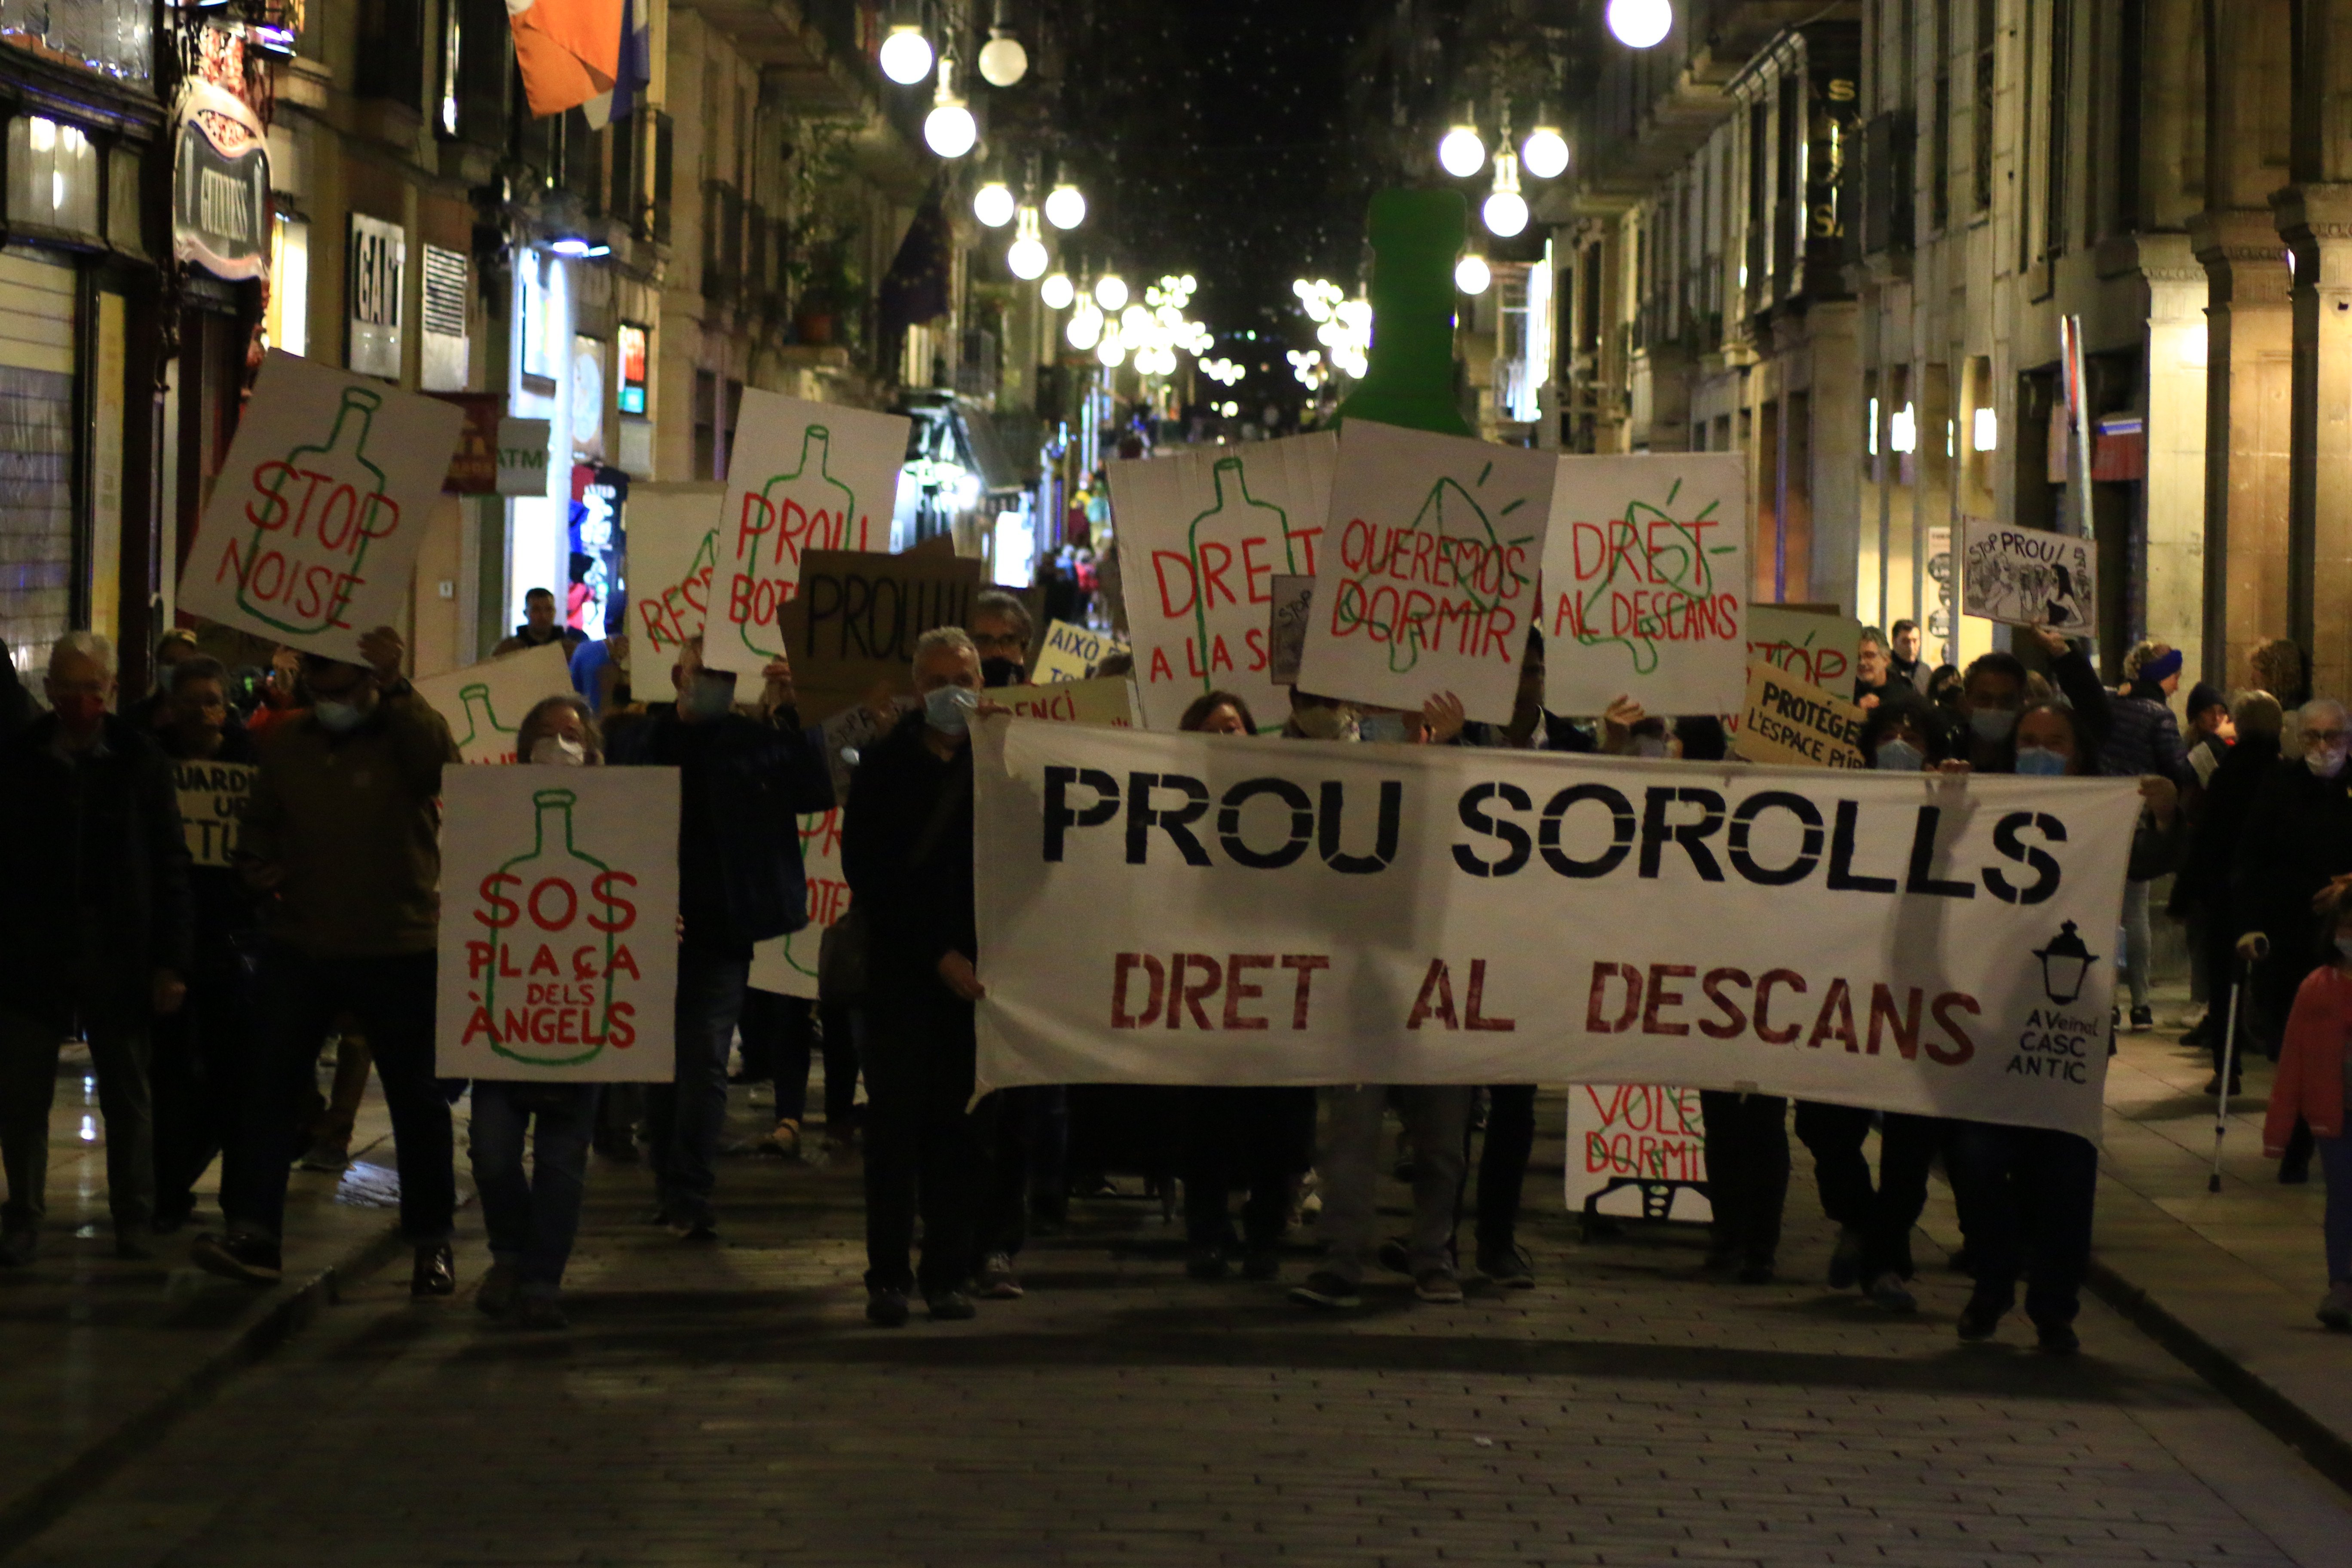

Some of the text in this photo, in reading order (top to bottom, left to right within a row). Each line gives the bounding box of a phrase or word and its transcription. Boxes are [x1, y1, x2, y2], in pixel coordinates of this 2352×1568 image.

[245, 460, 400, 555] STOP
[1151, 527, 1323, 619] DRET
[1341, 519, 1525, 598] QUEREMOS
[1572, 520, 1718, 585] DRET
[217, 538, 365, 629] NOISE
[1331, 578, 1516, 663] DORMIR
[1555, 590, 1738, 641] AL DESCANS
[1748, 707, 1824, 763] L'ESPACE
[1763, 681, 1862, 746] PROTÉGE
[1042, 765, 2068, 905] PROU SOROLLS
[473, 871, 637, 932] SOS
[465, 941, 640, 980] PLAÇA
[461, 991, 635, 1048] ÀNGELS
[526, 983, 595, 1005] DELS
[1110, 952, 1982, 1066] DRET AL DESCANS
[2006, 1054, 2087, 1085] ANTIC
[2020, 1032, 2086, 1057] CASC
[1586, 1084, 1701, 1136] VOLE
[1586, 1130, 1697, 1181] DORMI
